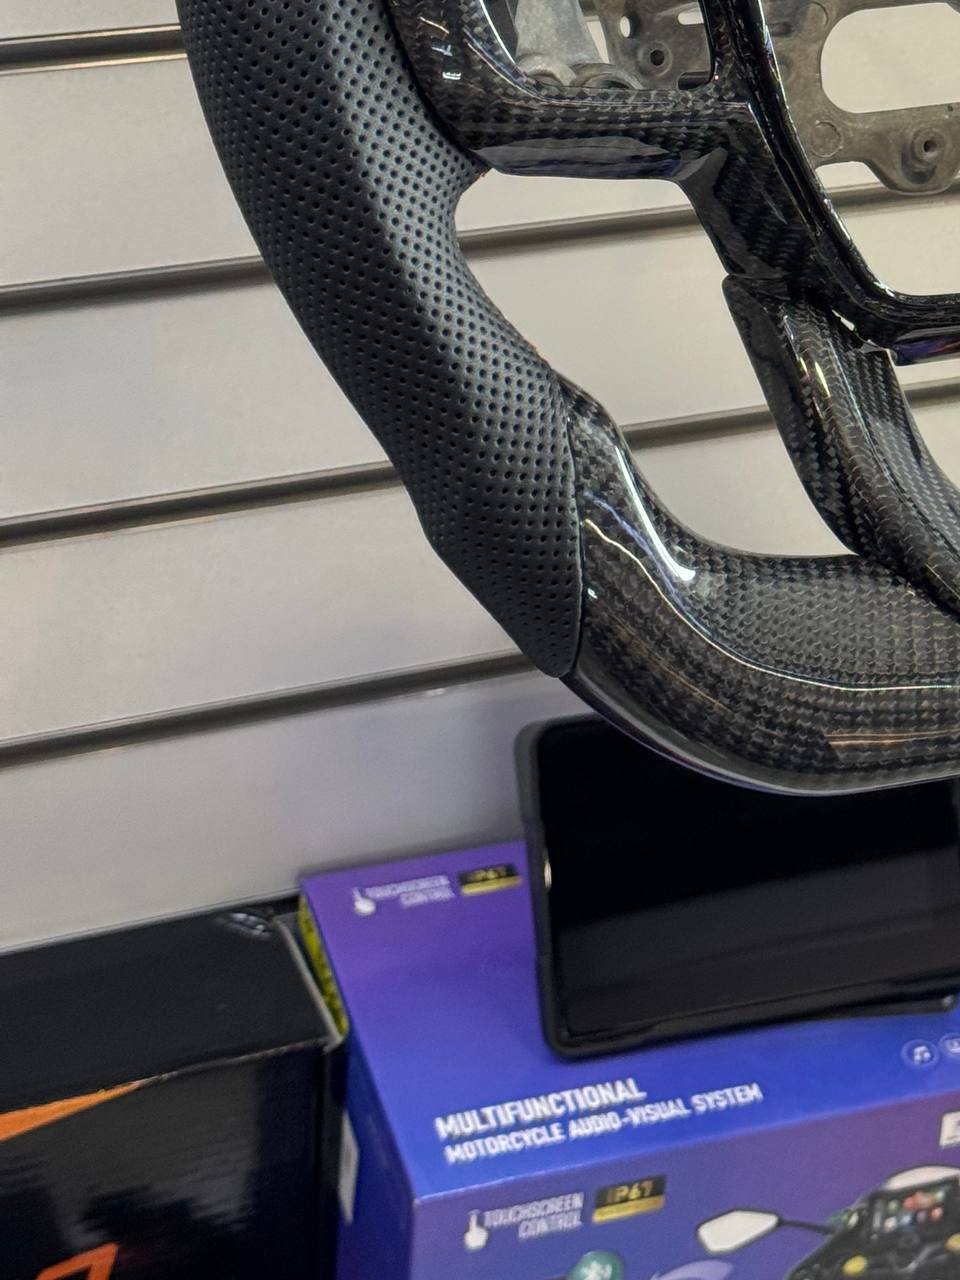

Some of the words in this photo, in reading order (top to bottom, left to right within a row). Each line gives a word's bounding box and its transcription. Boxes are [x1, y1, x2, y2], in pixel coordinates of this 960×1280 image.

[434, 1077, 648, 1141] MULTIFUNCTIONAL
[443, 1122, 566, 1165] MOTORCYCLE
[568, 1097, 692, 1141] AUDIO-VISUAL
[690, 1082, 764, 1114] SYSTEM
[607, 1180, 653, 1202] IP67
